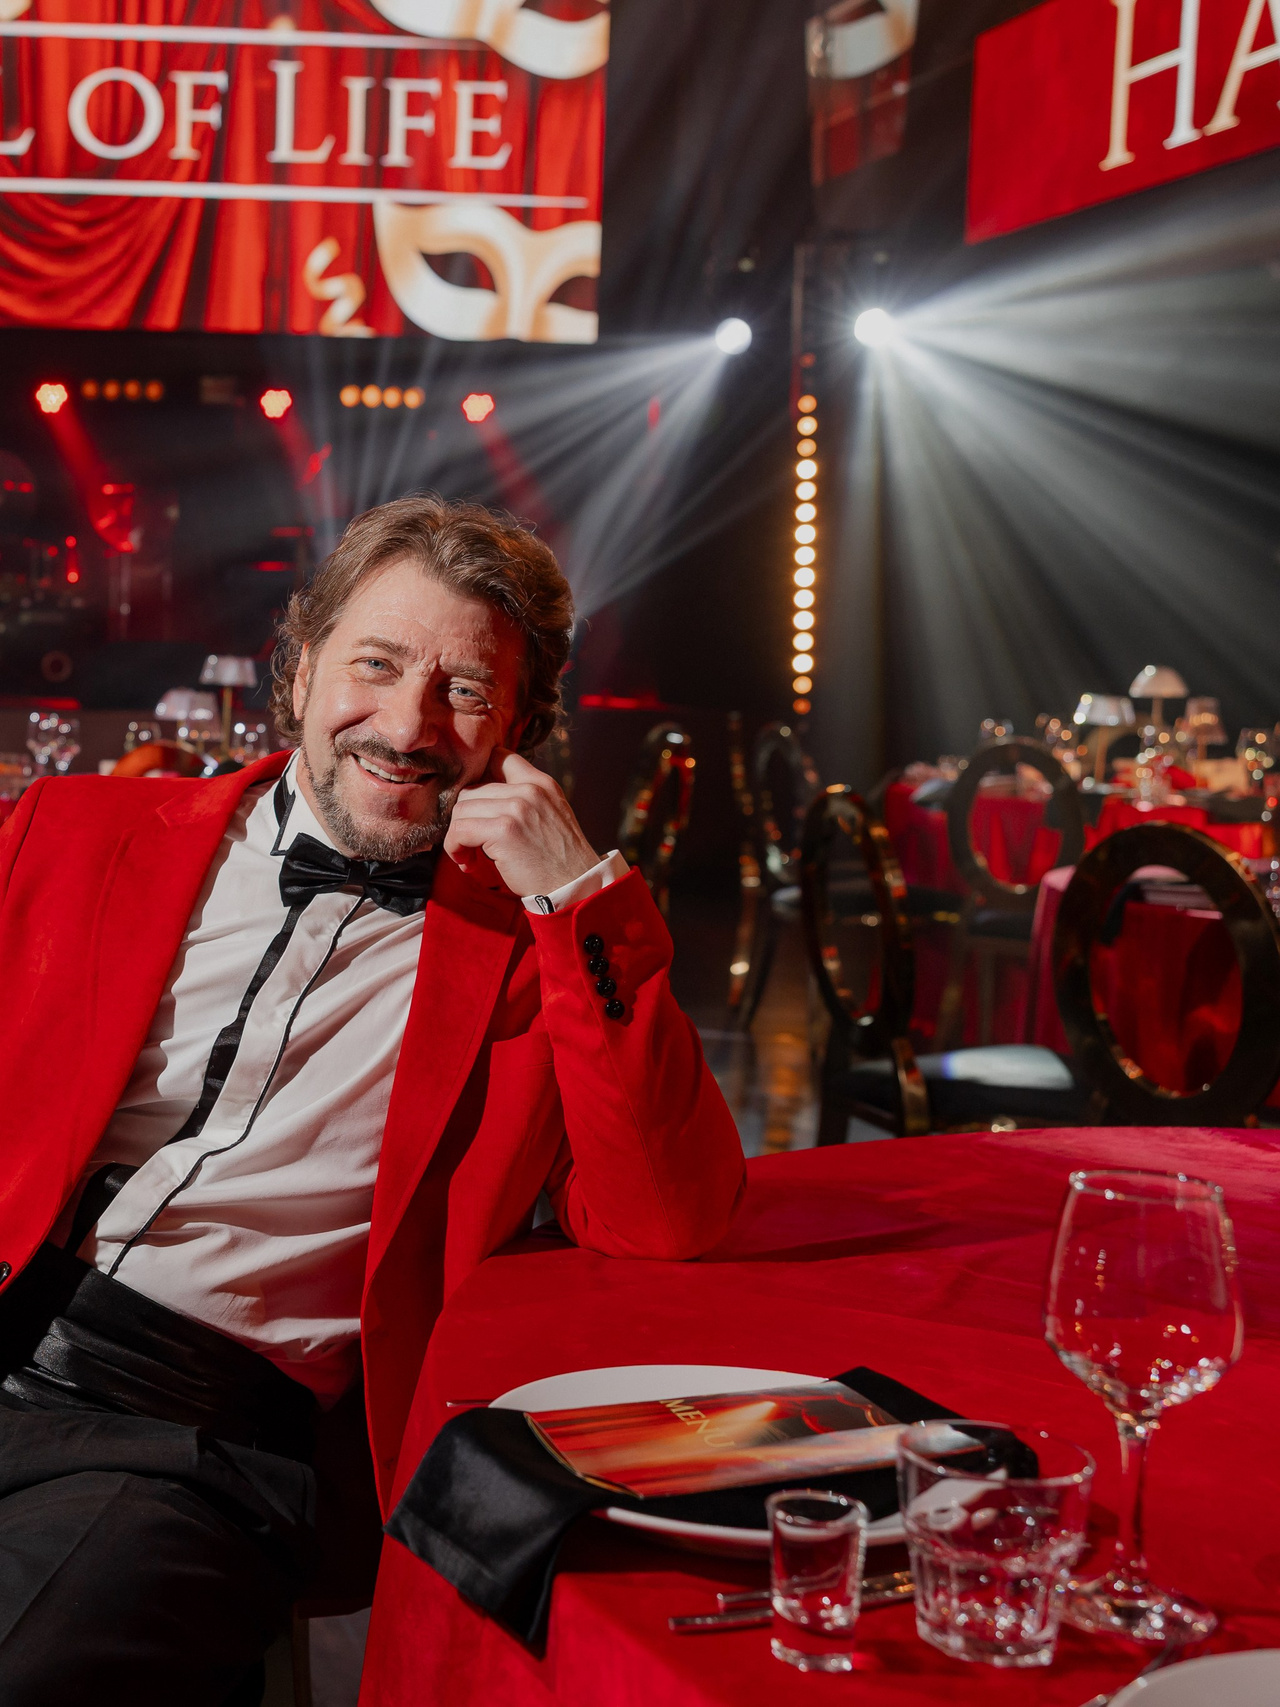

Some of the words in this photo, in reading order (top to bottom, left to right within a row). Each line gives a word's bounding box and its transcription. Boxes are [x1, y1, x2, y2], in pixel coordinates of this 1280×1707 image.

[67, 67, 229, 160] OF
[267, 60, 512, 170] LIFE
[660, 1399, 735, 1448] MENU
